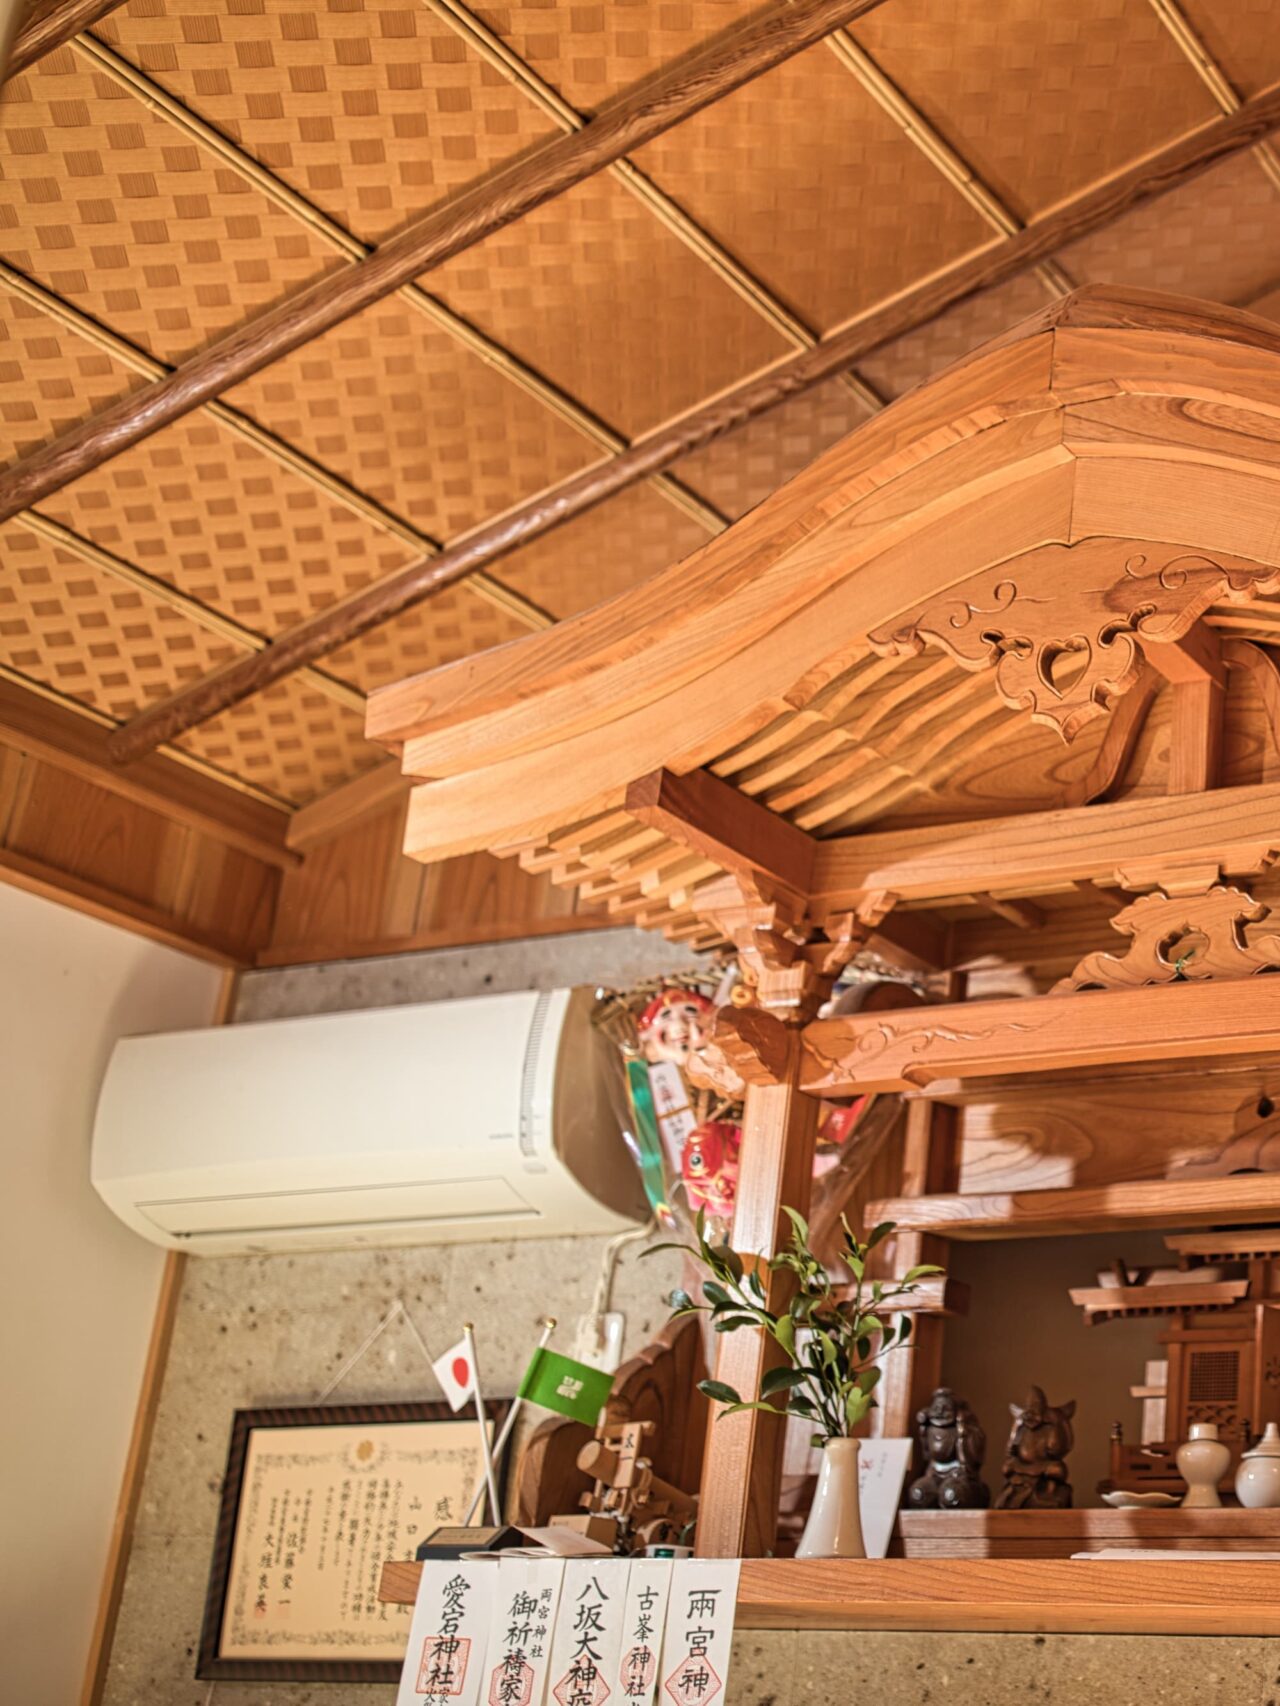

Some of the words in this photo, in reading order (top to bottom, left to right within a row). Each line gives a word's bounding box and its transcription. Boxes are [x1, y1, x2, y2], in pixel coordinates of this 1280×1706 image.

[426, 1574, 471, 1687] 愛宕神社
[624, 1585, 660, 1706] 古峯神社
